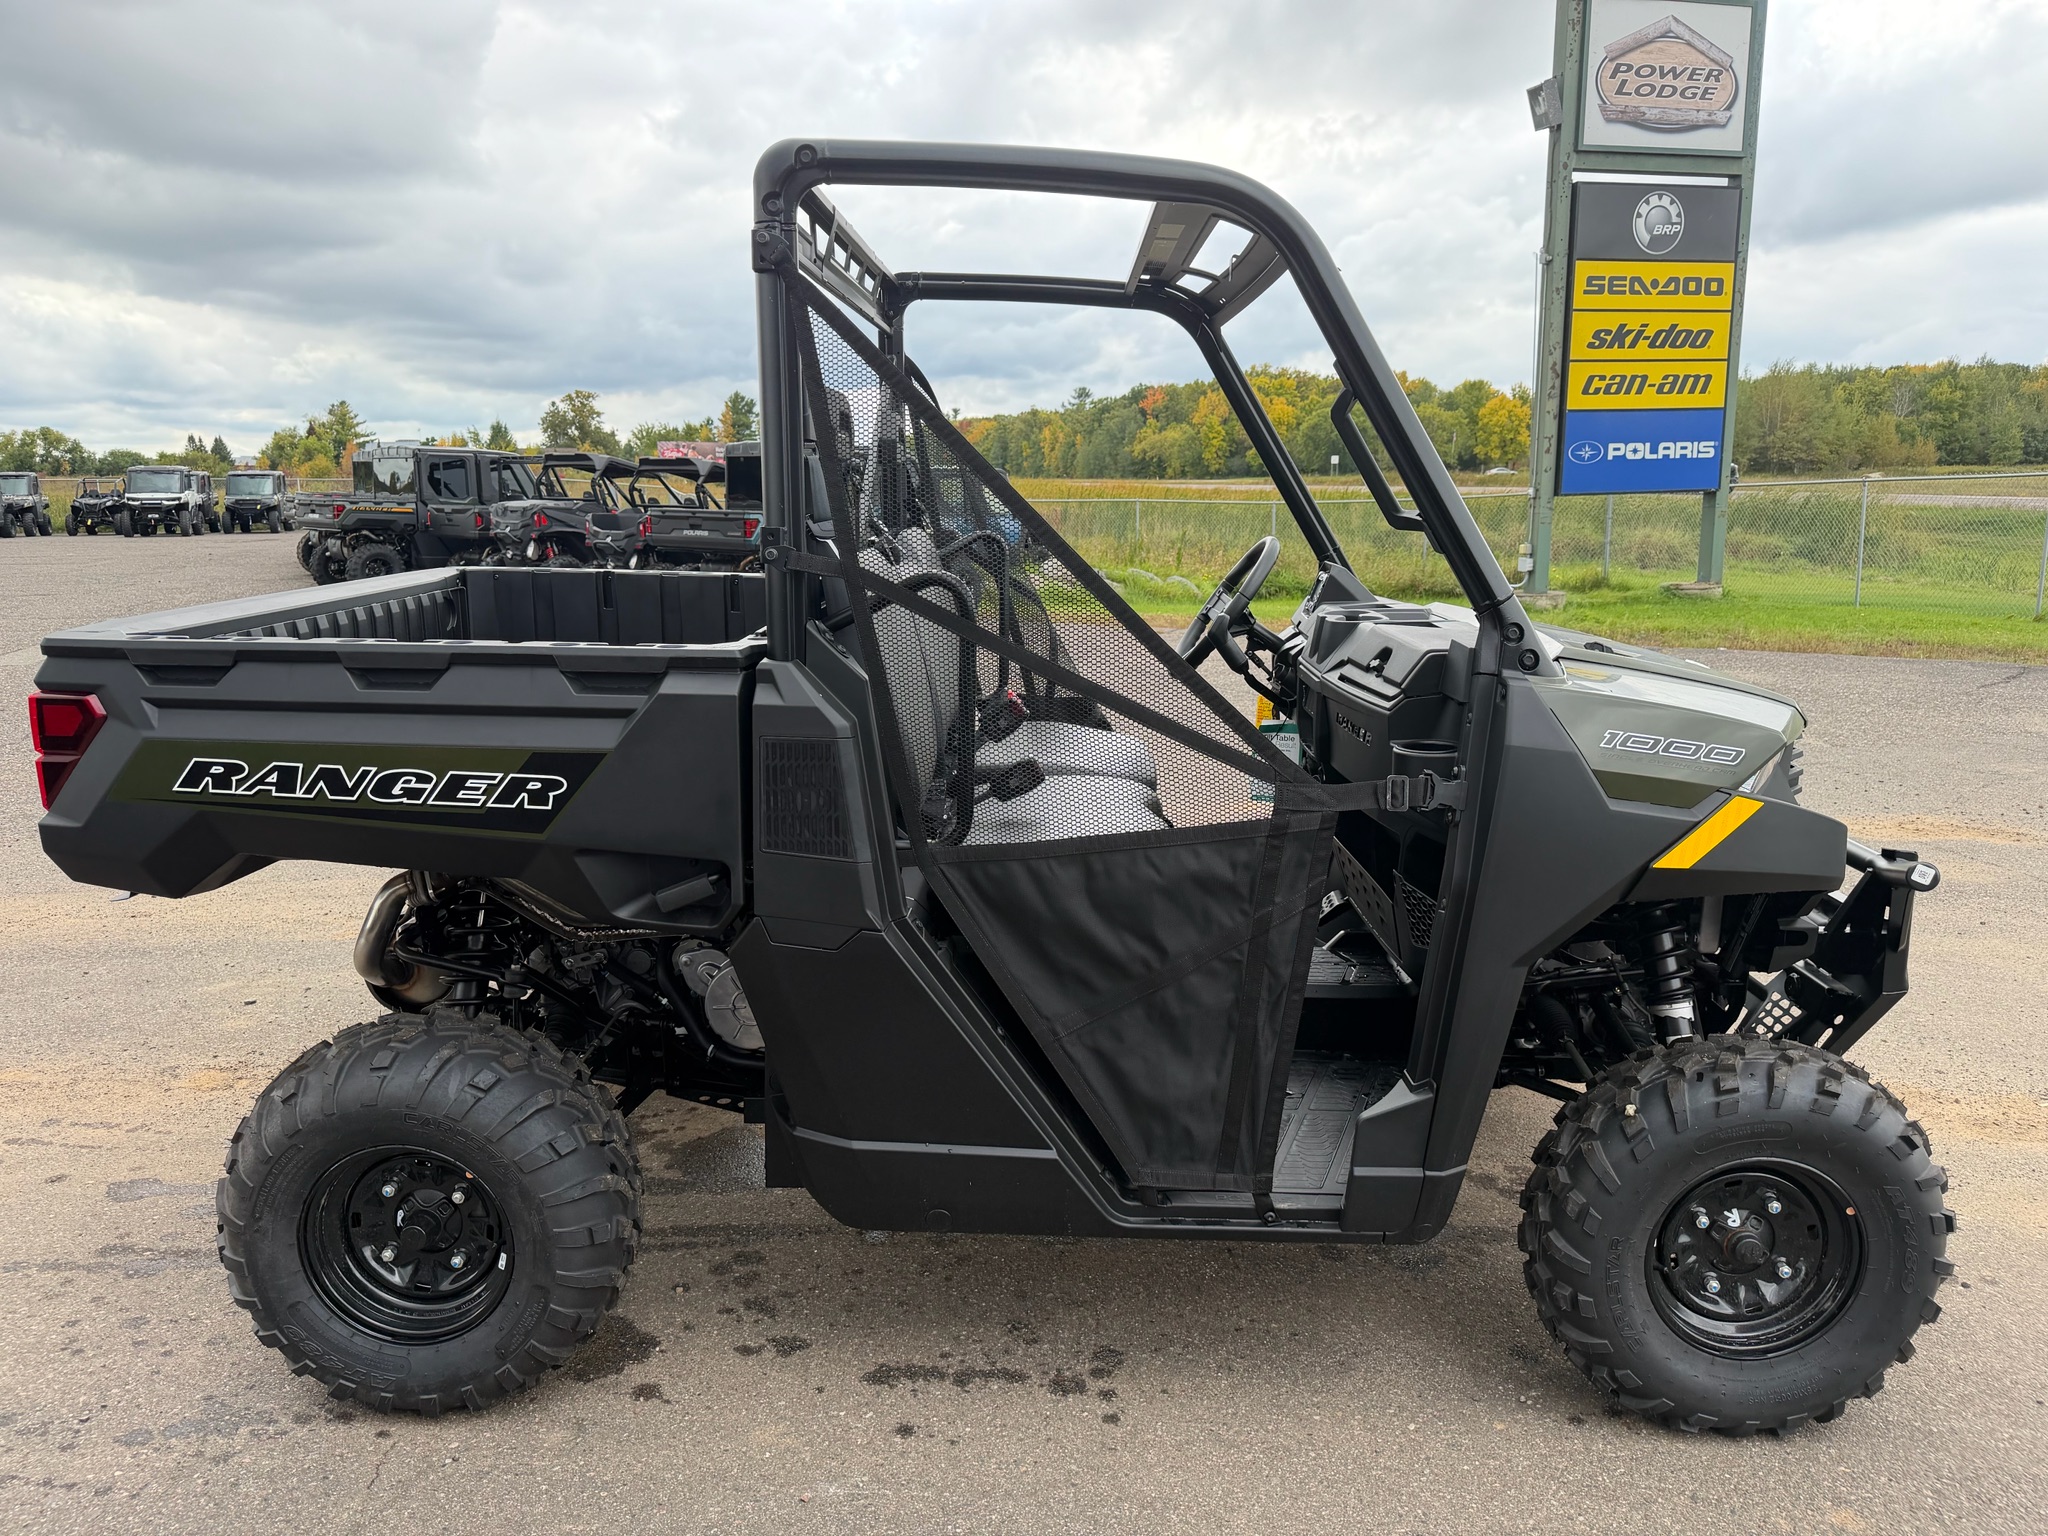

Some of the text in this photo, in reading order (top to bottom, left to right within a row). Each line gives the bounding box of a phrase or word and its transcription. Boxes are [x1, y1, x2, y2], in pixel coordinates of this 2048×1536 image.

[1608, 62, 1724, 83] POWER
[1613, 78, 1719, 102] LODGE
[1653, 224, 1681, 236] BRP
[1586, 323, 1714, 350] ski-doo
[1581, 373, 1713, 396] can-am
[1607, 441, 1715, 460] POLARIS
[1276, 734, 1295, 742] Table
[1599, 729, 1746, 765] 1000
[172, 757, 568, 811] RANGER
[1883, 1185, 1919, 1294] AT489
[283, 1325, 397, 1388] AT489
